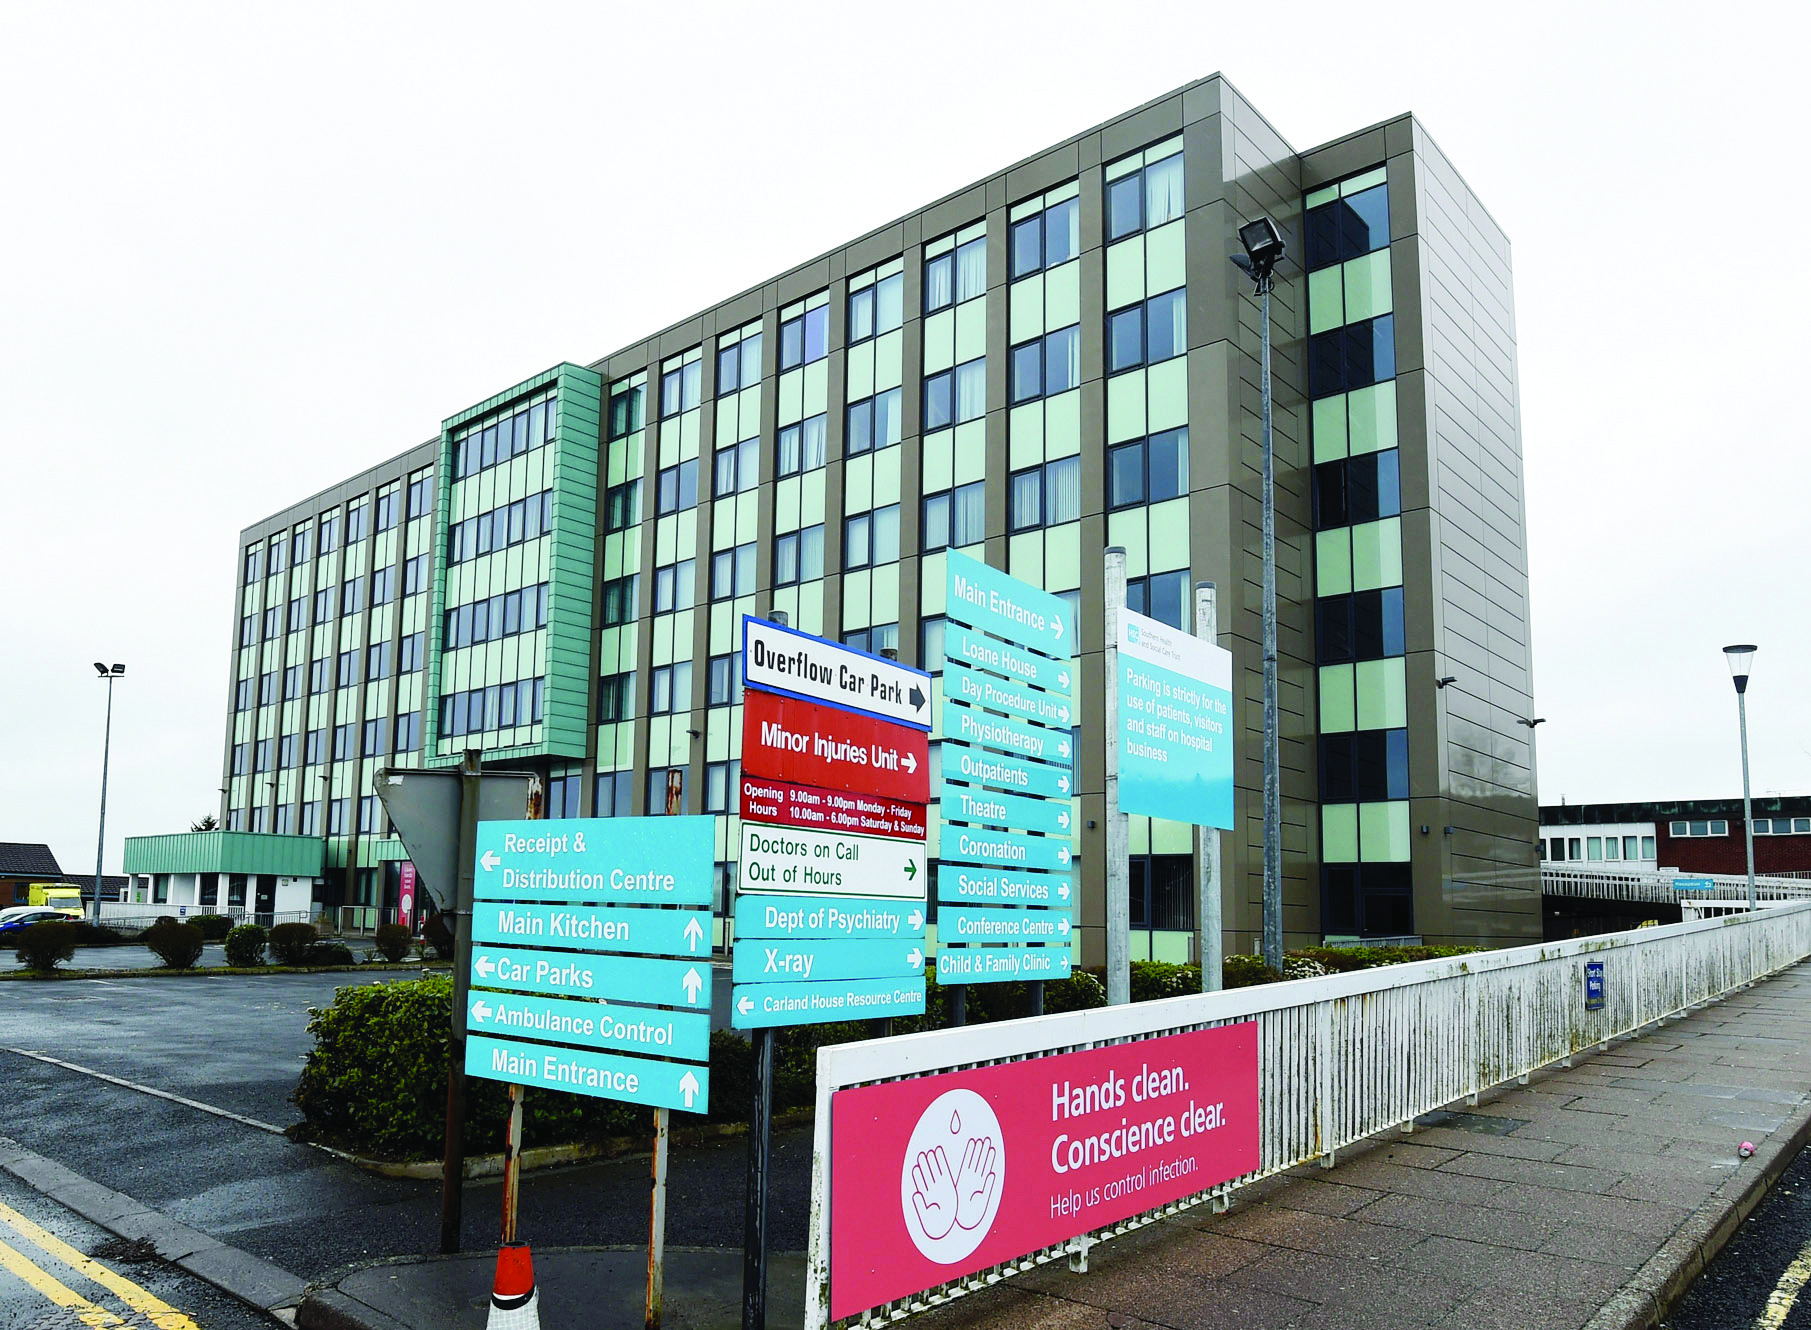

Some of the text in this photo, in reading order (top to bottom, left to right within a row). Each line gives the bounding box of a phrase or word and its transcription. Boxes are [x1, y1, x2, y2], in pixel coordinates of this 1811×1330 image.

[955, 575, 1045, 631] Main Entrance
[754, 640, 902, 704] Overflow Car Park
[963, 636, 1037, 678] Loane House
[962, 676, 1058, 719] Day Procedure Unit
[1127, 668, 1226, 715] Parking is strictly for the
[1127, 695, 1222, 734] use of patients, visitors
[761, 721, 898, 771] Minor Injuries Unit
[962, 715, 1043, 756] Physiotherapy
[1127, 718, 1212, 753] and staff on hospital
[1127, 738, 1167, 762] business
[961, 755, 1028, 786] Outpatients
[744, 783, 783, 802] Opening
[790, 790, 820, 805] 9.00am
[827, 795, 855, 811] 9.00pm
[857, 800, 885, 816] Monday
[891, 805, 912, 820] Friday
[960, 794, 1006, 820] Theatre
[750, 802, 777, 816] Hours
[790, 806, 824, 822] 10.00am
[831, 812, 859, 827] 6.00pm
[861, 816, 892, 832] Saturday
[894, 821, 899, 831] &
[900, 822, 924, 836] Sunday
[505, 832, 586, 857] Receipt &
[751, 834, 859, 861] Doctors on Call
[959, 835, 1026, 860] Coronation
[503, 869, 674, 891] Distribution Centre
[749, 862, 841, 885] Out of Hours
[959, 875, 1048, 899] Social Services
[498, 911, 629, 940] Main Kitchen
[766, 907, 900, 934] Dept of Psychiatry
[958, 917, 1054, 934] Conference Centre
[497, 958, 593, 988] Car Parks
[764, 948, 814, 978] X-ray
[941, 953, 1050, 975] Child & Family Clinic
[764, 990, 921, 1012] Carland House Resource Centre
[495, 1005, 672, 1045] Ambulance Control
[492, 1048, 639, 1093] Main Entrance
[1052, 1064, 1189, 1121] Hands clean.
[1051, 1101, 1226, 1174] Conscience clear.
[1050, 1154, 1199, 1218] Help us control infection.
